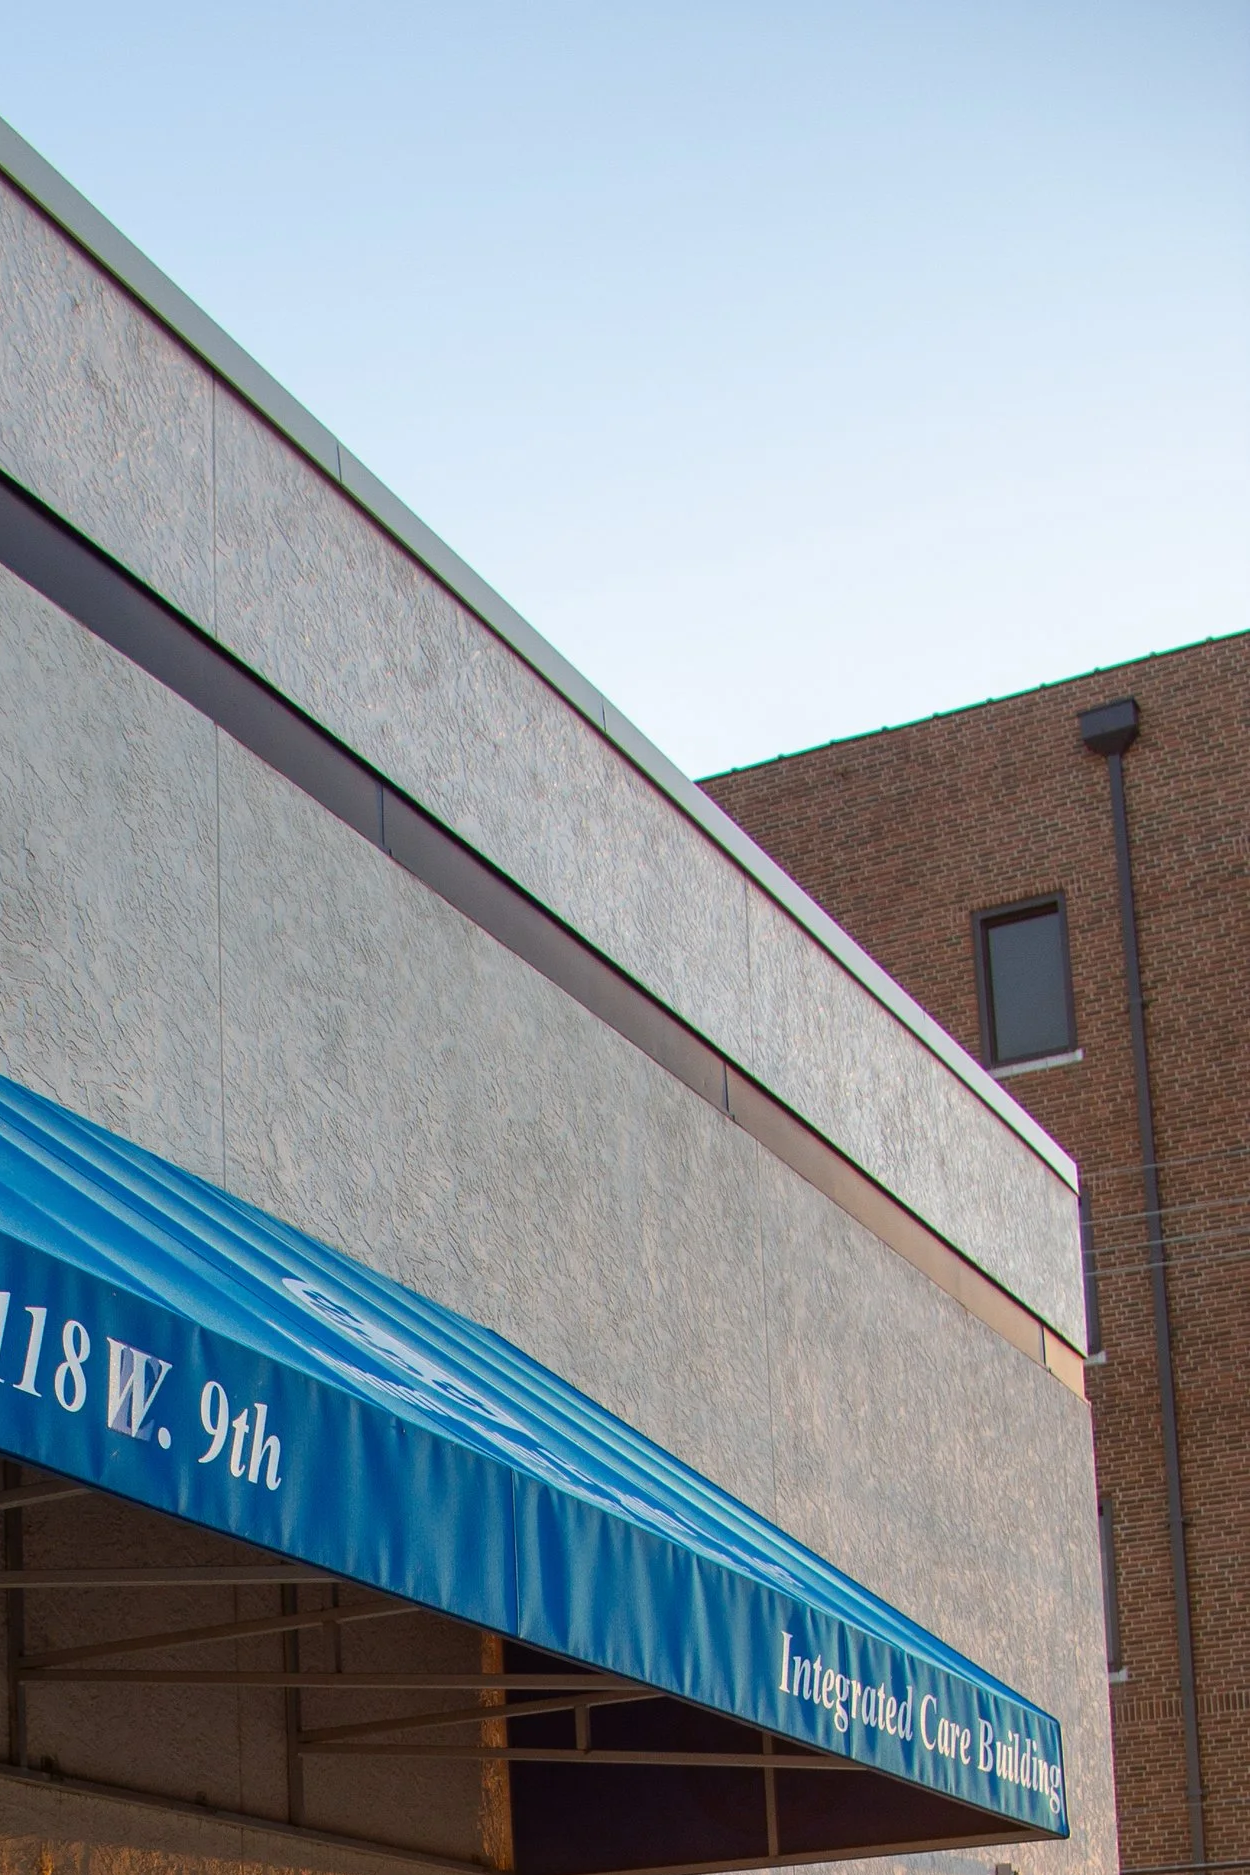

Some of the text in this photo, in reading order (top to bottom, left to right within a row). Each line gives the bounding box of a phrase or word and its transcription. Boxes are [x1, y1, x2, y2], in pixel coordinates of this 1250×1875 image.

[106, 1336, 173, 1449] W.
[198, 1380, 282, 1490] 9th
[779, 1631, 1061, 1814] Integrated Care Building
